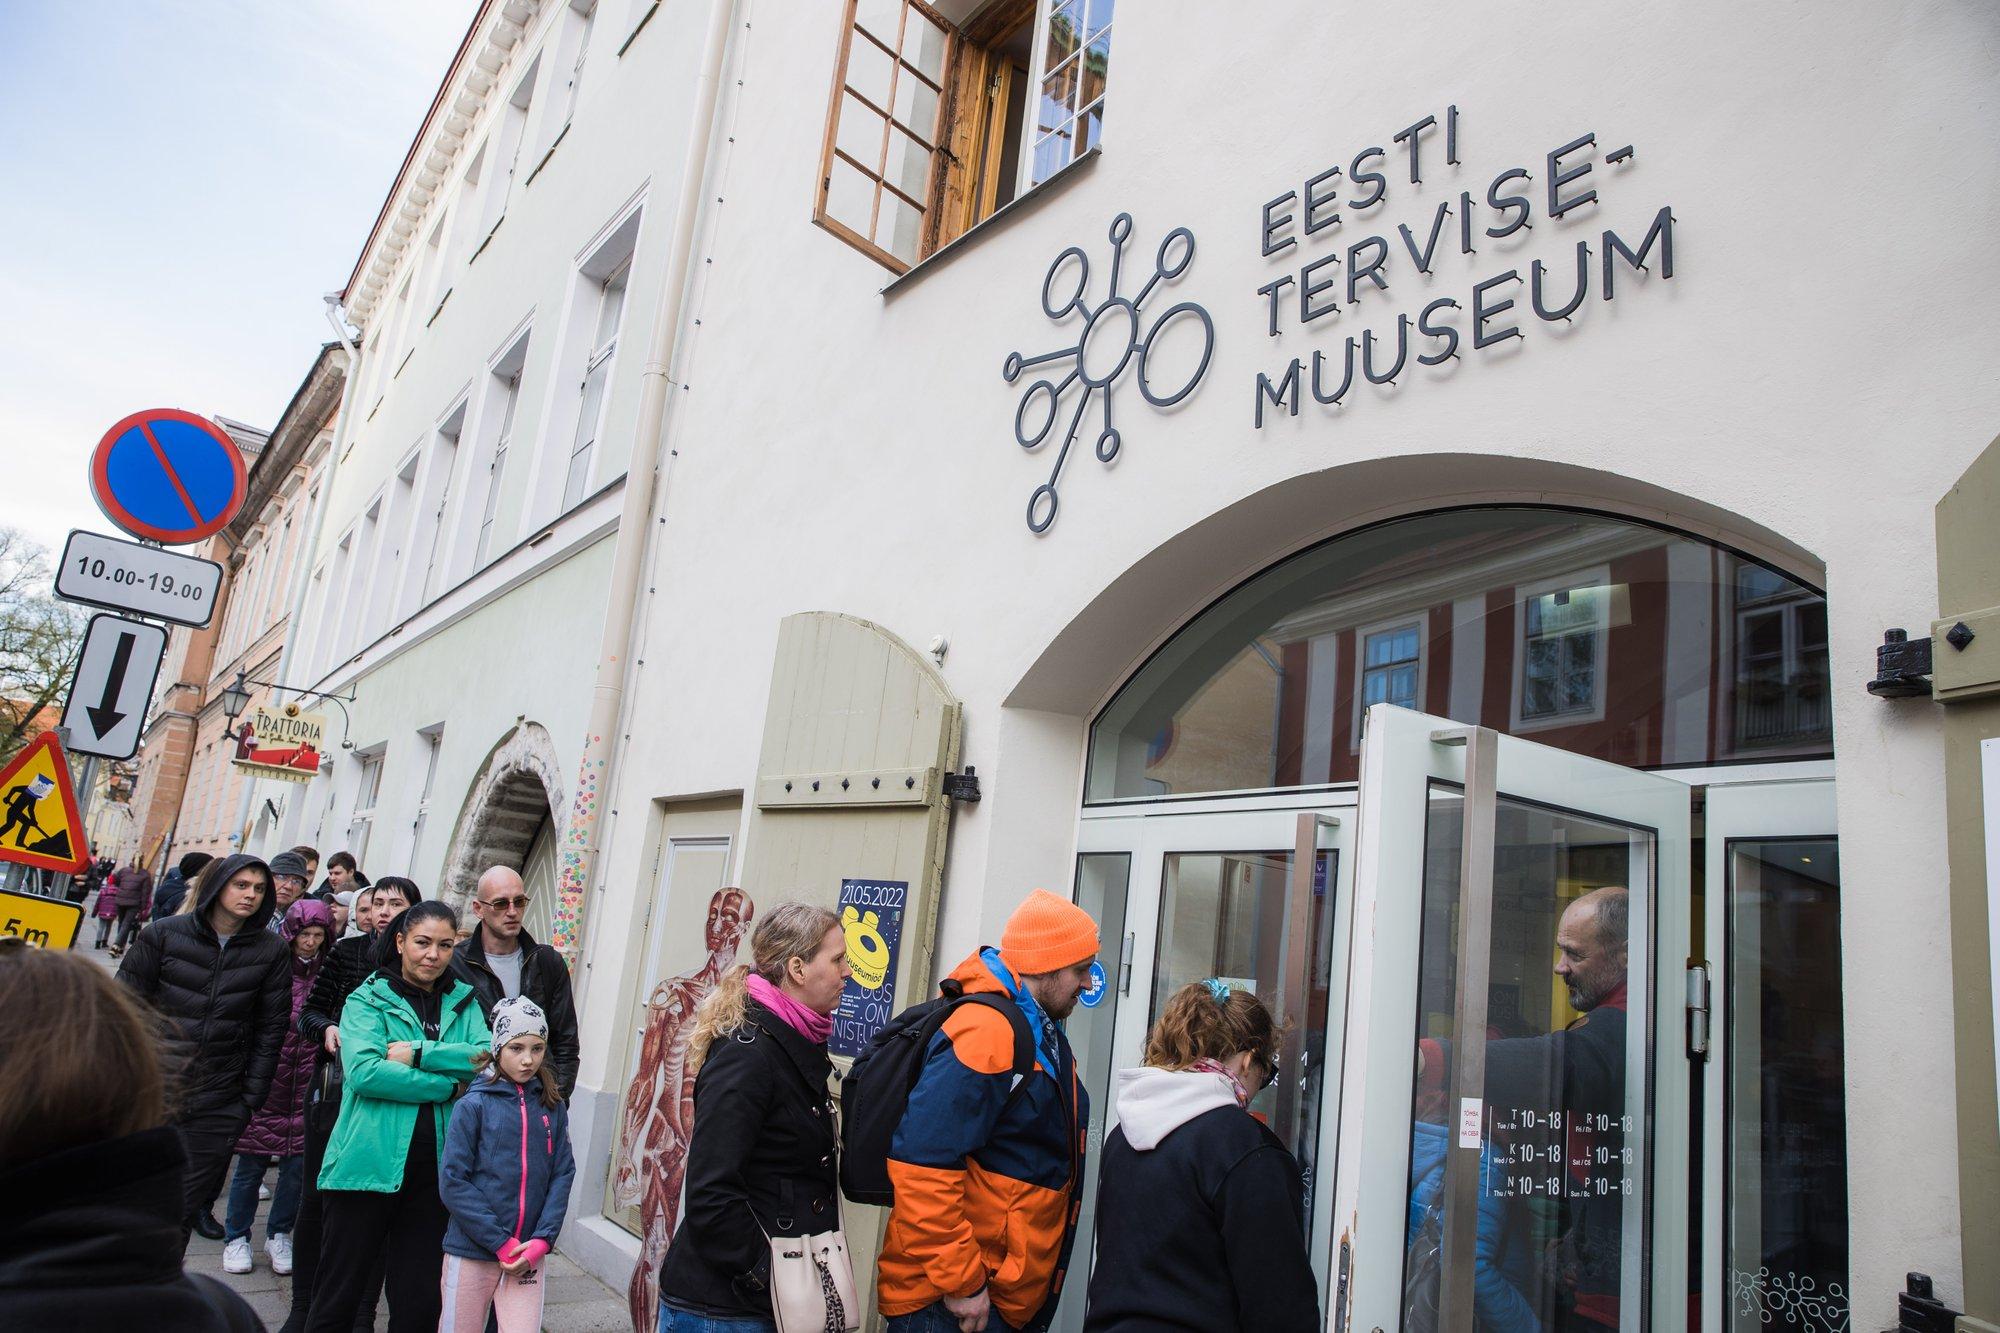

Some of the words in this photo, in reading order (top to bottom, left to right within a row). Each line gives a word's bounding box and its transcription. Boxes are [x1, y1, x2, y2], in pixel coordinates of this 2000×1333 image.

[1261, 104, 1460, 258] EESTI
[1257, 132, 1635, 338] TERVISE-
[1254, 205, 1676, 430] MUUSEUM
[78, 556, 203, 601] 10.00-19.00
[257, 714, 320, 739] TRATTORIA
[841, 885, 904, 907] 21.05.2022
[865, 1003, 890, 1025] ON
